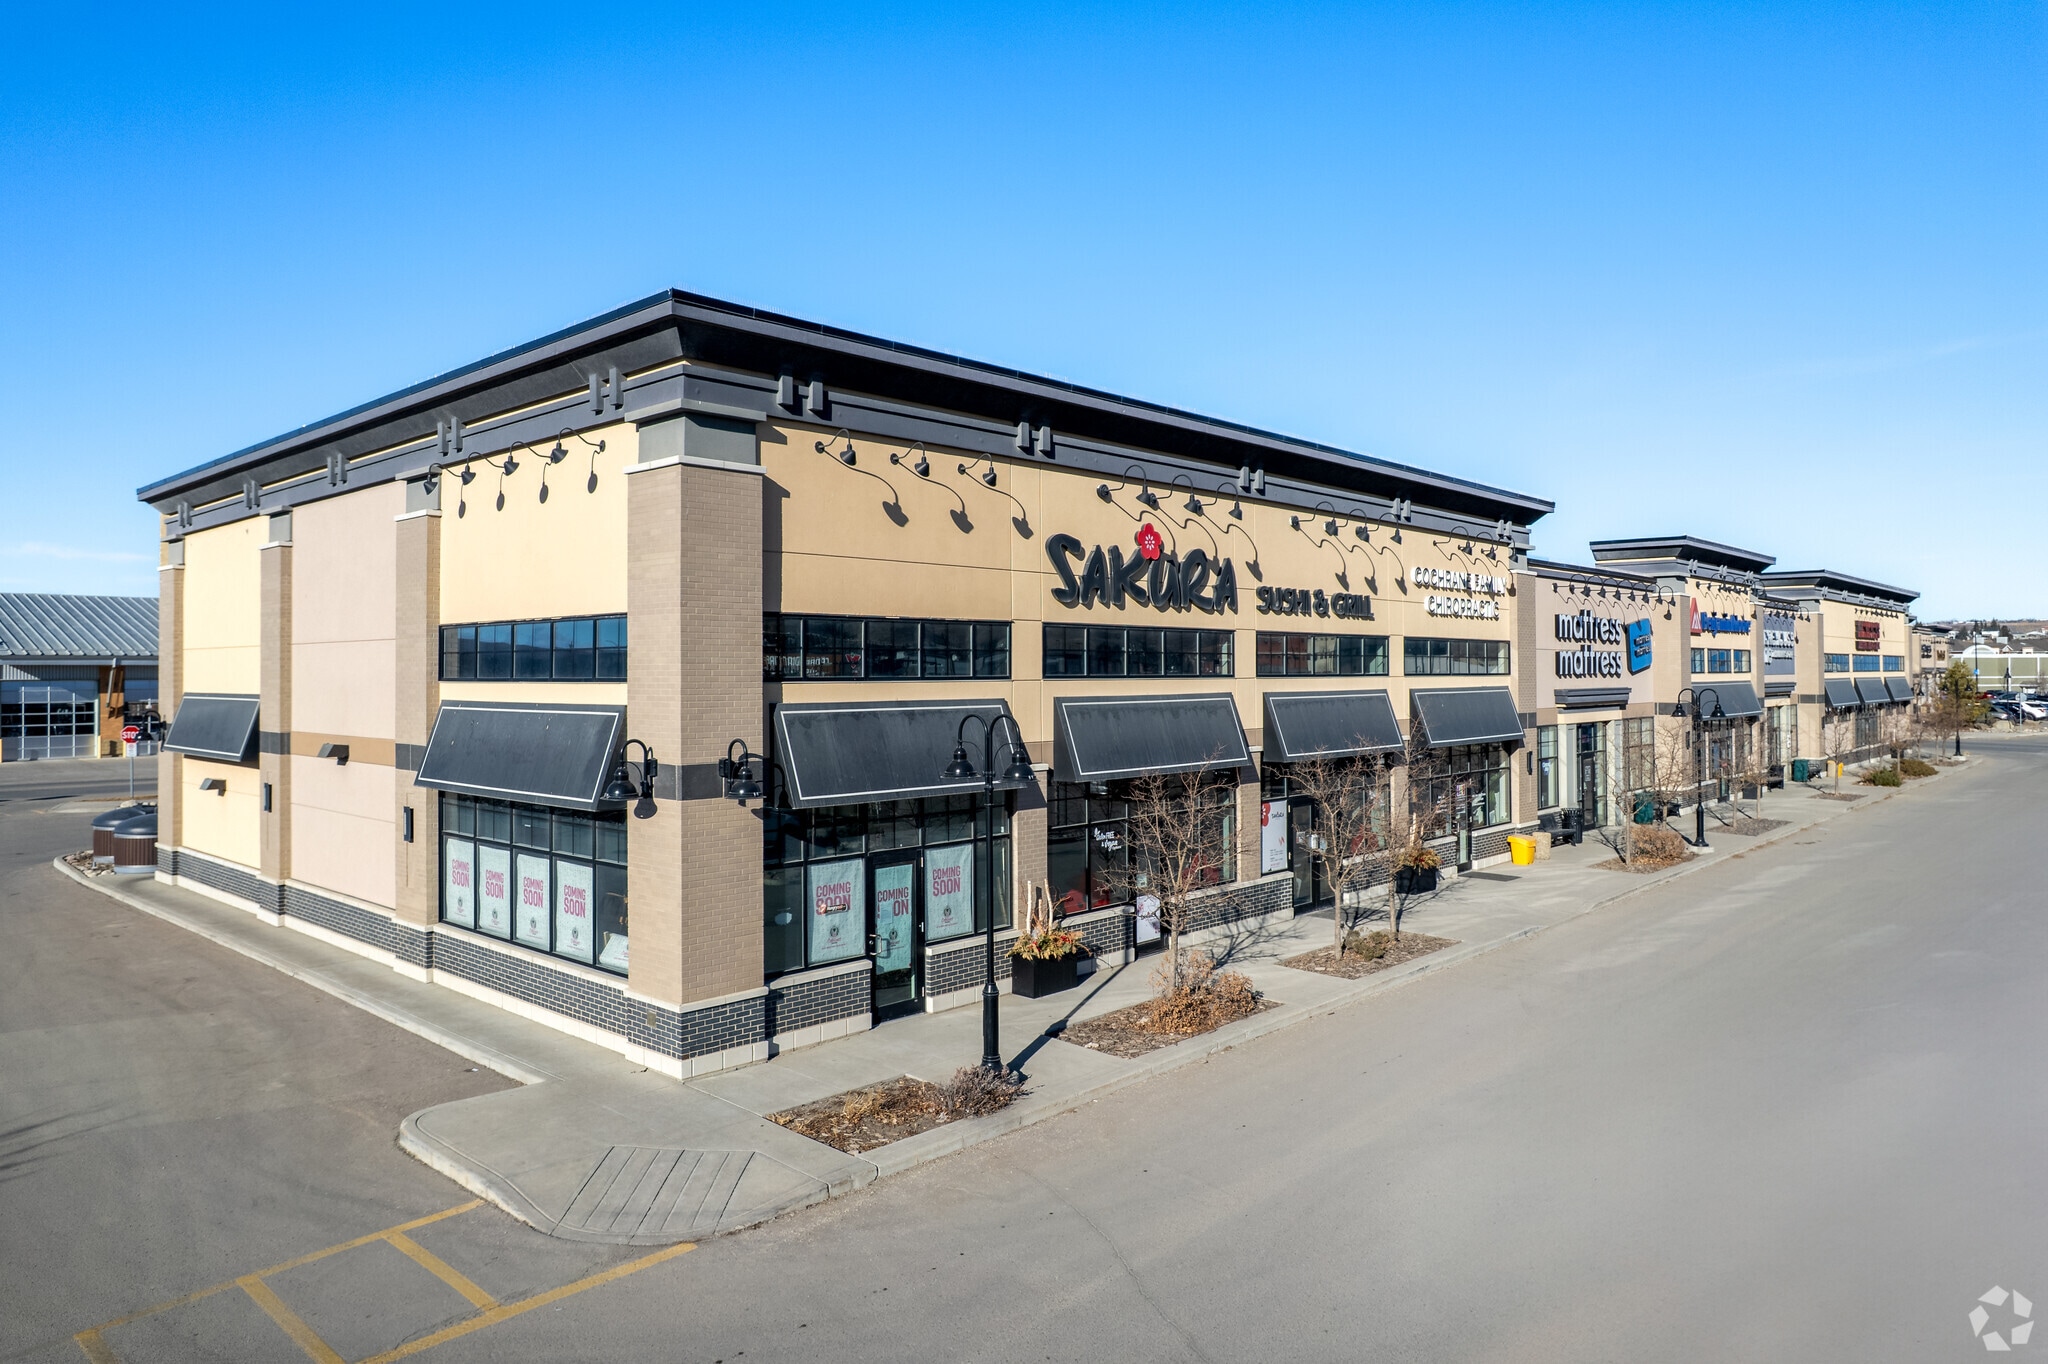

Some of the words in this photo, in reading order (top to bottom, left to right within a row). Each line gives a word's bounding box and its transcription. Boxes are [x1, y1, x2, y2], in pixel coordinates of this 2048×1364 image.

[1046, 533, 1238, 612] SAKURA
[1411, 567, 1472, 590] COCHRANE
[1474, 574, 1506, 594] FAMILY
[1256, 586, 1311, 616] SUSHI
[1313, 589, 1329, 617] &
[1331, 592, 1375, 620] GRILL
[1424, 596, 1499, 617] CHIROPRACTIC
[1556, 609, 1622, 643] mattress
[1556, 645, 1622, 677] mattress
[452, 859, 470, 873] COMING
[932, 865, 961, 881] COMING
[452, 870, 470, 889] SOON
[485, 869, 504, 884] COMING
[523, 876, 544, 892] COMING
[485, 882, 504, 900] SOON
[563, 884, 586, 901] COMING
[816, 881, 851, 898] COMING
[877, 886, 909, 903] COMING
[932, 877, 961, 897] SOON
[523, 889, 544, 908] SOON
[563, 897, 586, 919] SOON
[816, 894, 851, 916] SOON
